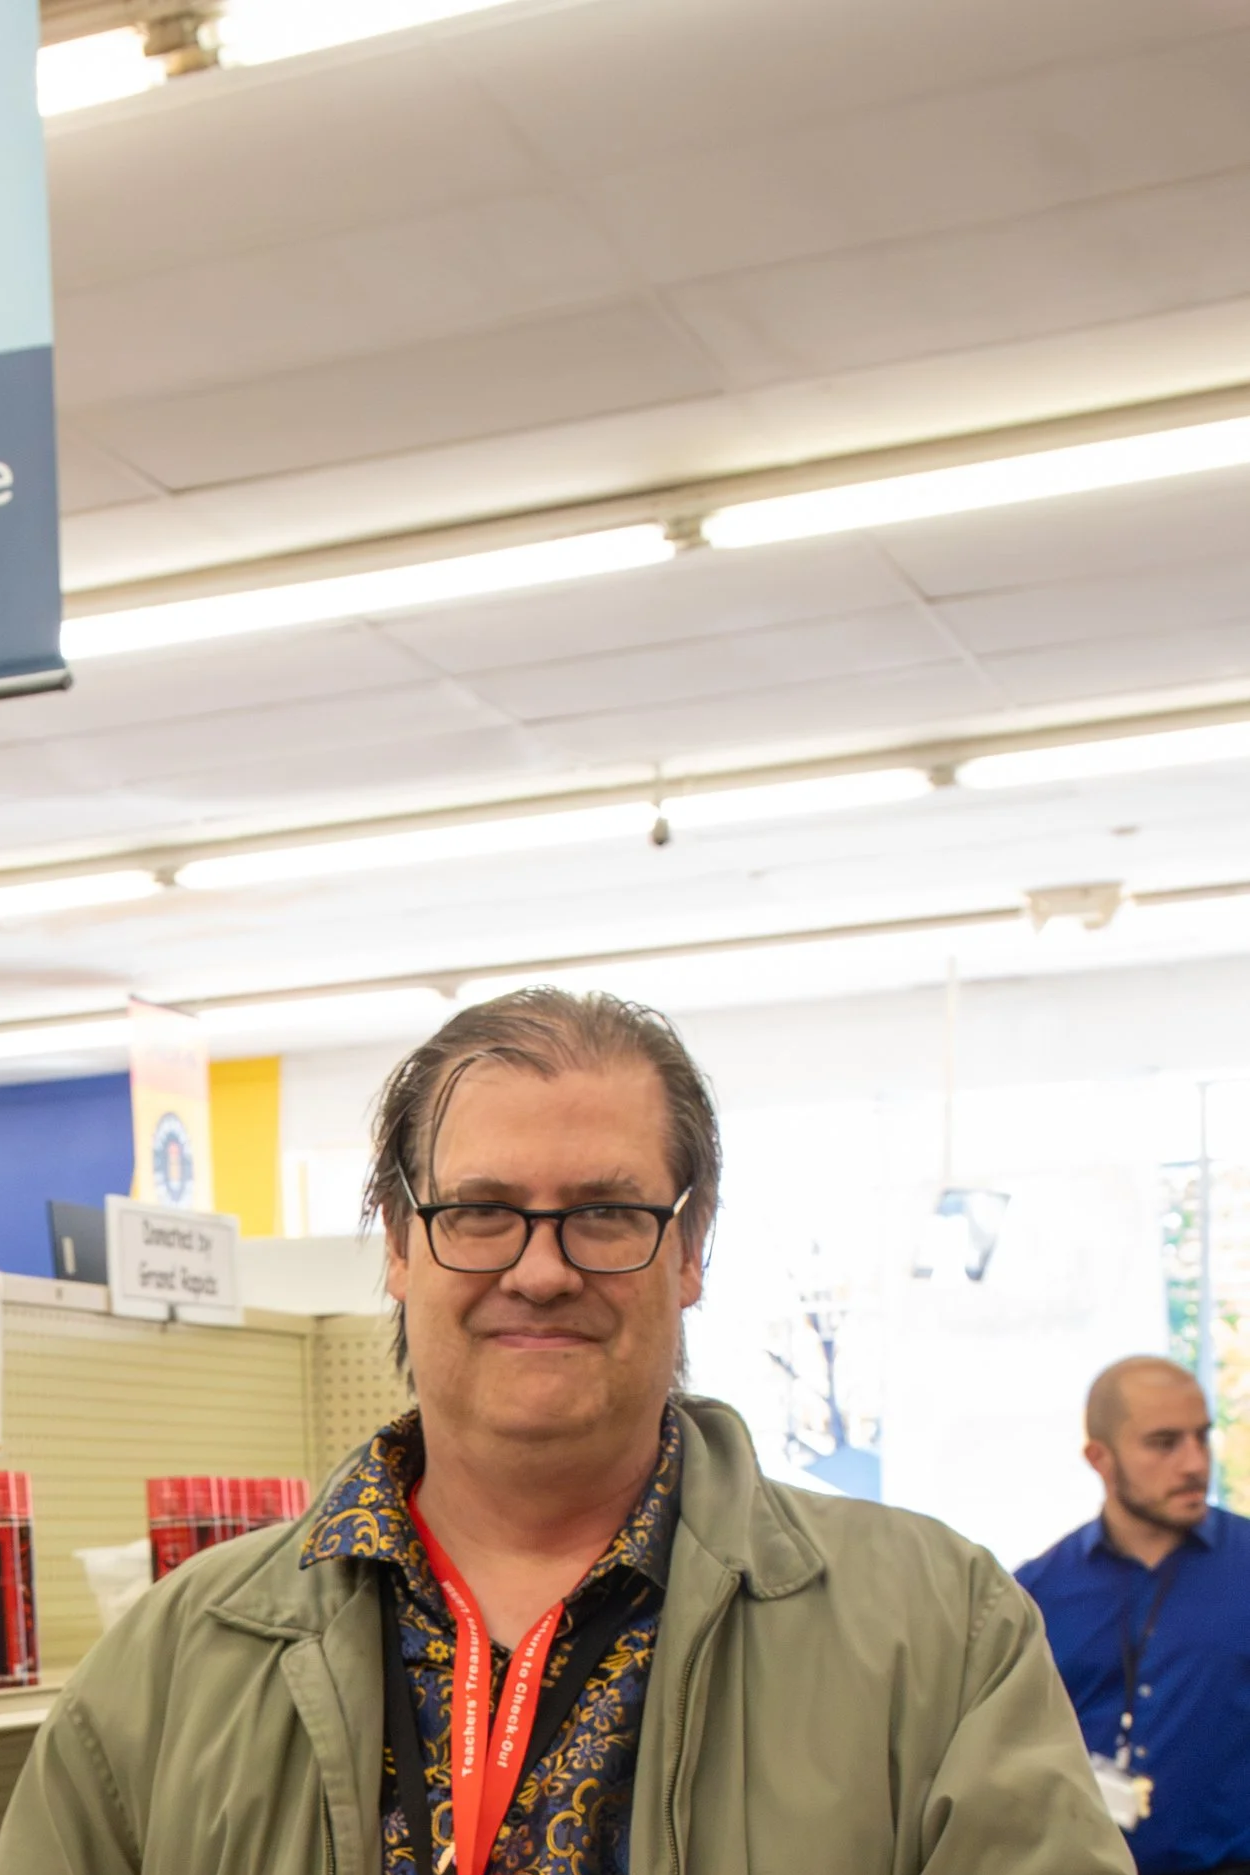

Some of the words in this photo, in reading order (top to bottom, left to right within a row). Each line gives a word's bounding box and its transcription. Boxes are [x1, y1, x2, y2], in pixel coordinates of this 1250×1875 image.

[142, 1219, 194, 1251] Donated
[197, 1231, 214, 1262] by
[138, 1261, 176, 1291] Grand
[180, 1267, 219, 1299] Rapids
[465, 1616, 480, 1690] Treasures
[518, 1660, 533, 1678] to
[497, 1682, 528, 1768] Check-Out
